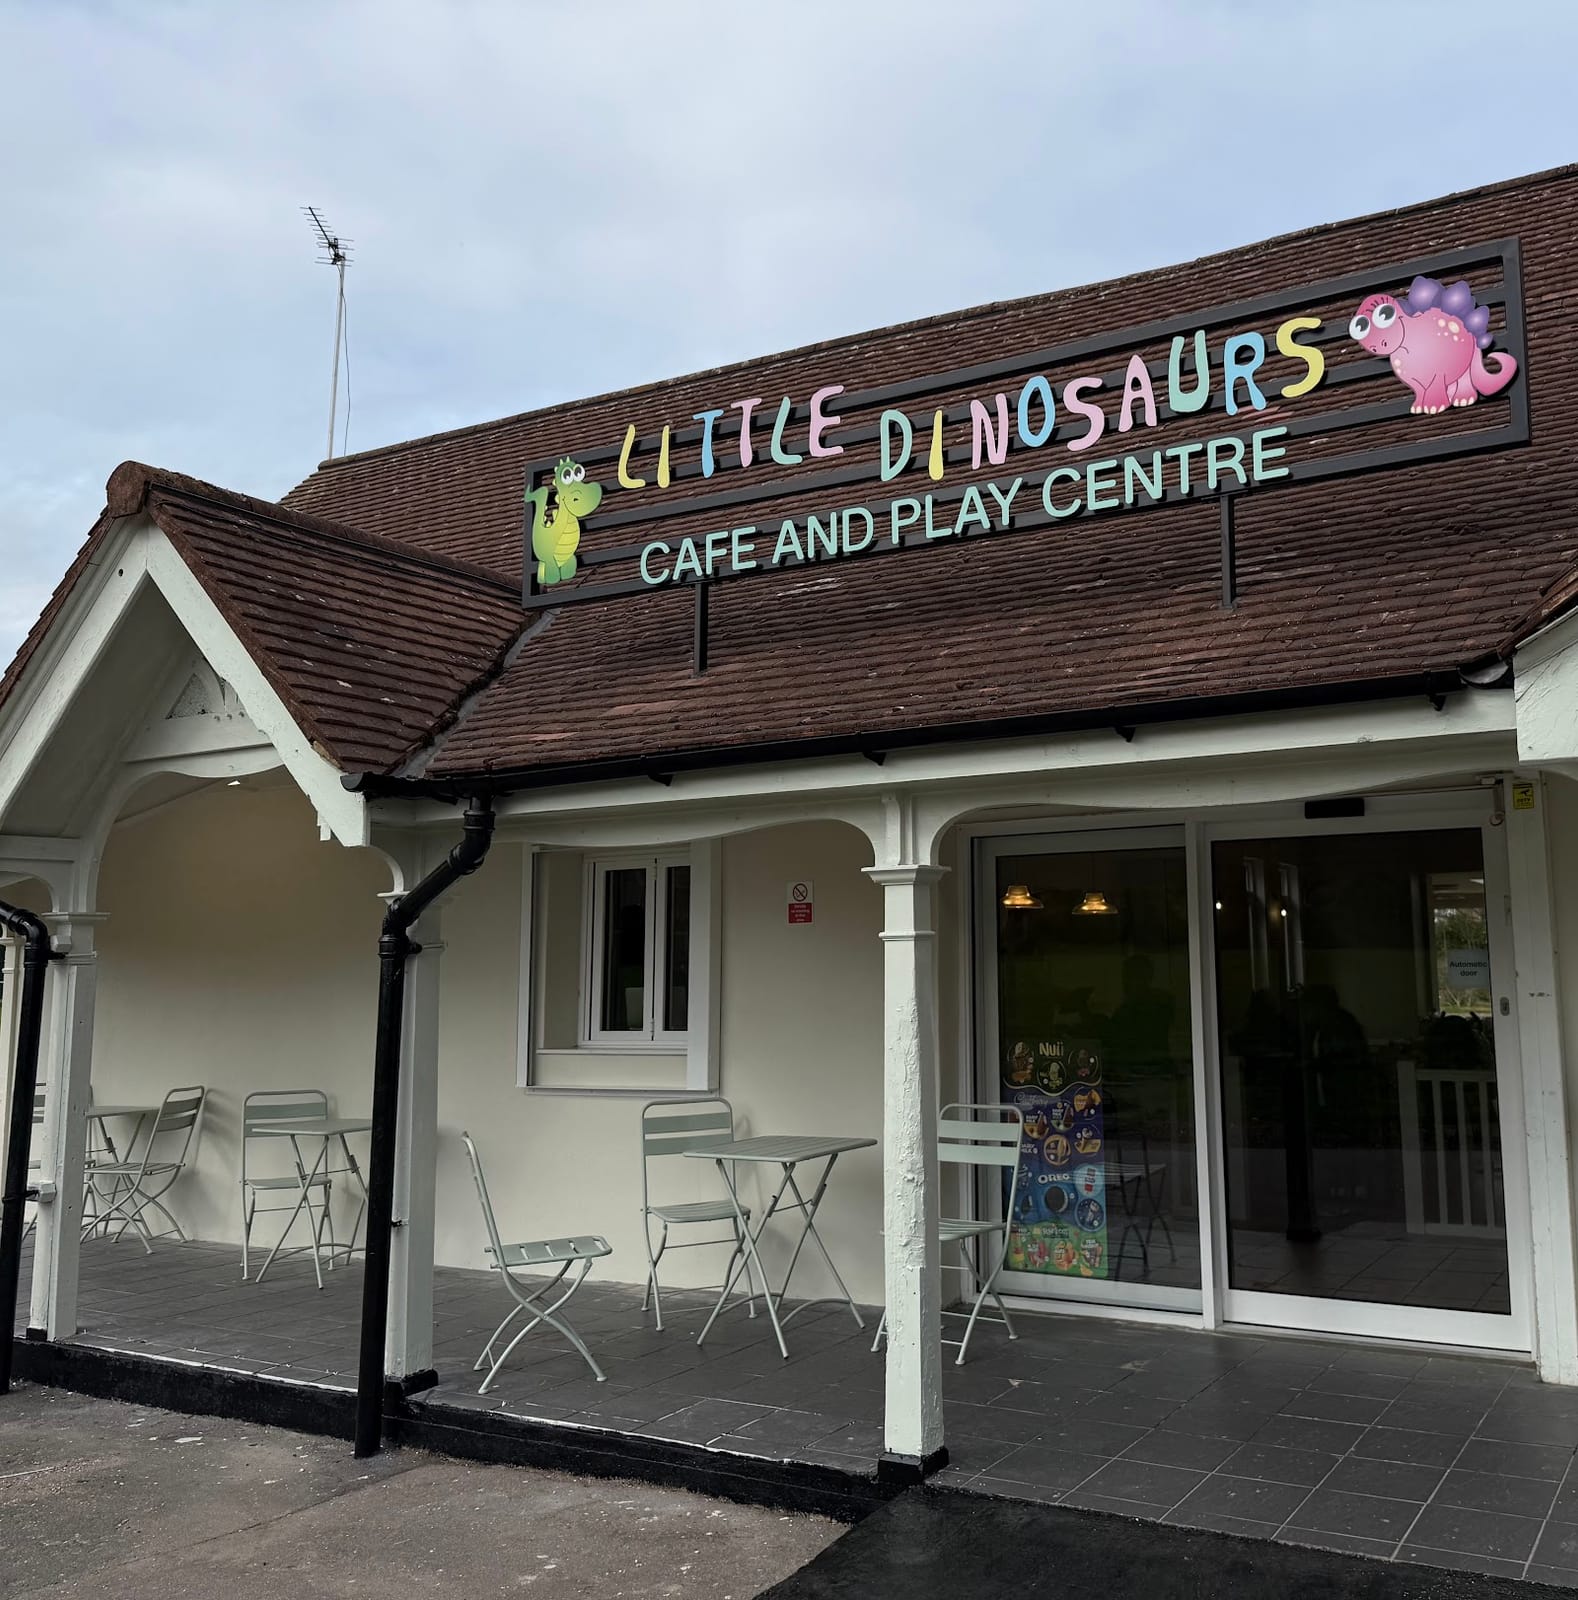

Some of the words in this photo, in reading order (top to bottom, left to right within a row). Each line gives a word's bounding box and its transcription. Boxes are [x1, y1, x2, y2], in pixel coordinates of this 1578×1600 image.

[618, 385, 844, 488] LITTLE
[879, 317, 1325, 482] DINOSAURS
[640, 526, 757, 584] CAFE
[772, 507, 874, 563] AND
[890, 477, 1023, 544] PLAY
[1042, 426, 1289, 518] CENTRE
[1038, 1173, 1070, 1184] OREO
